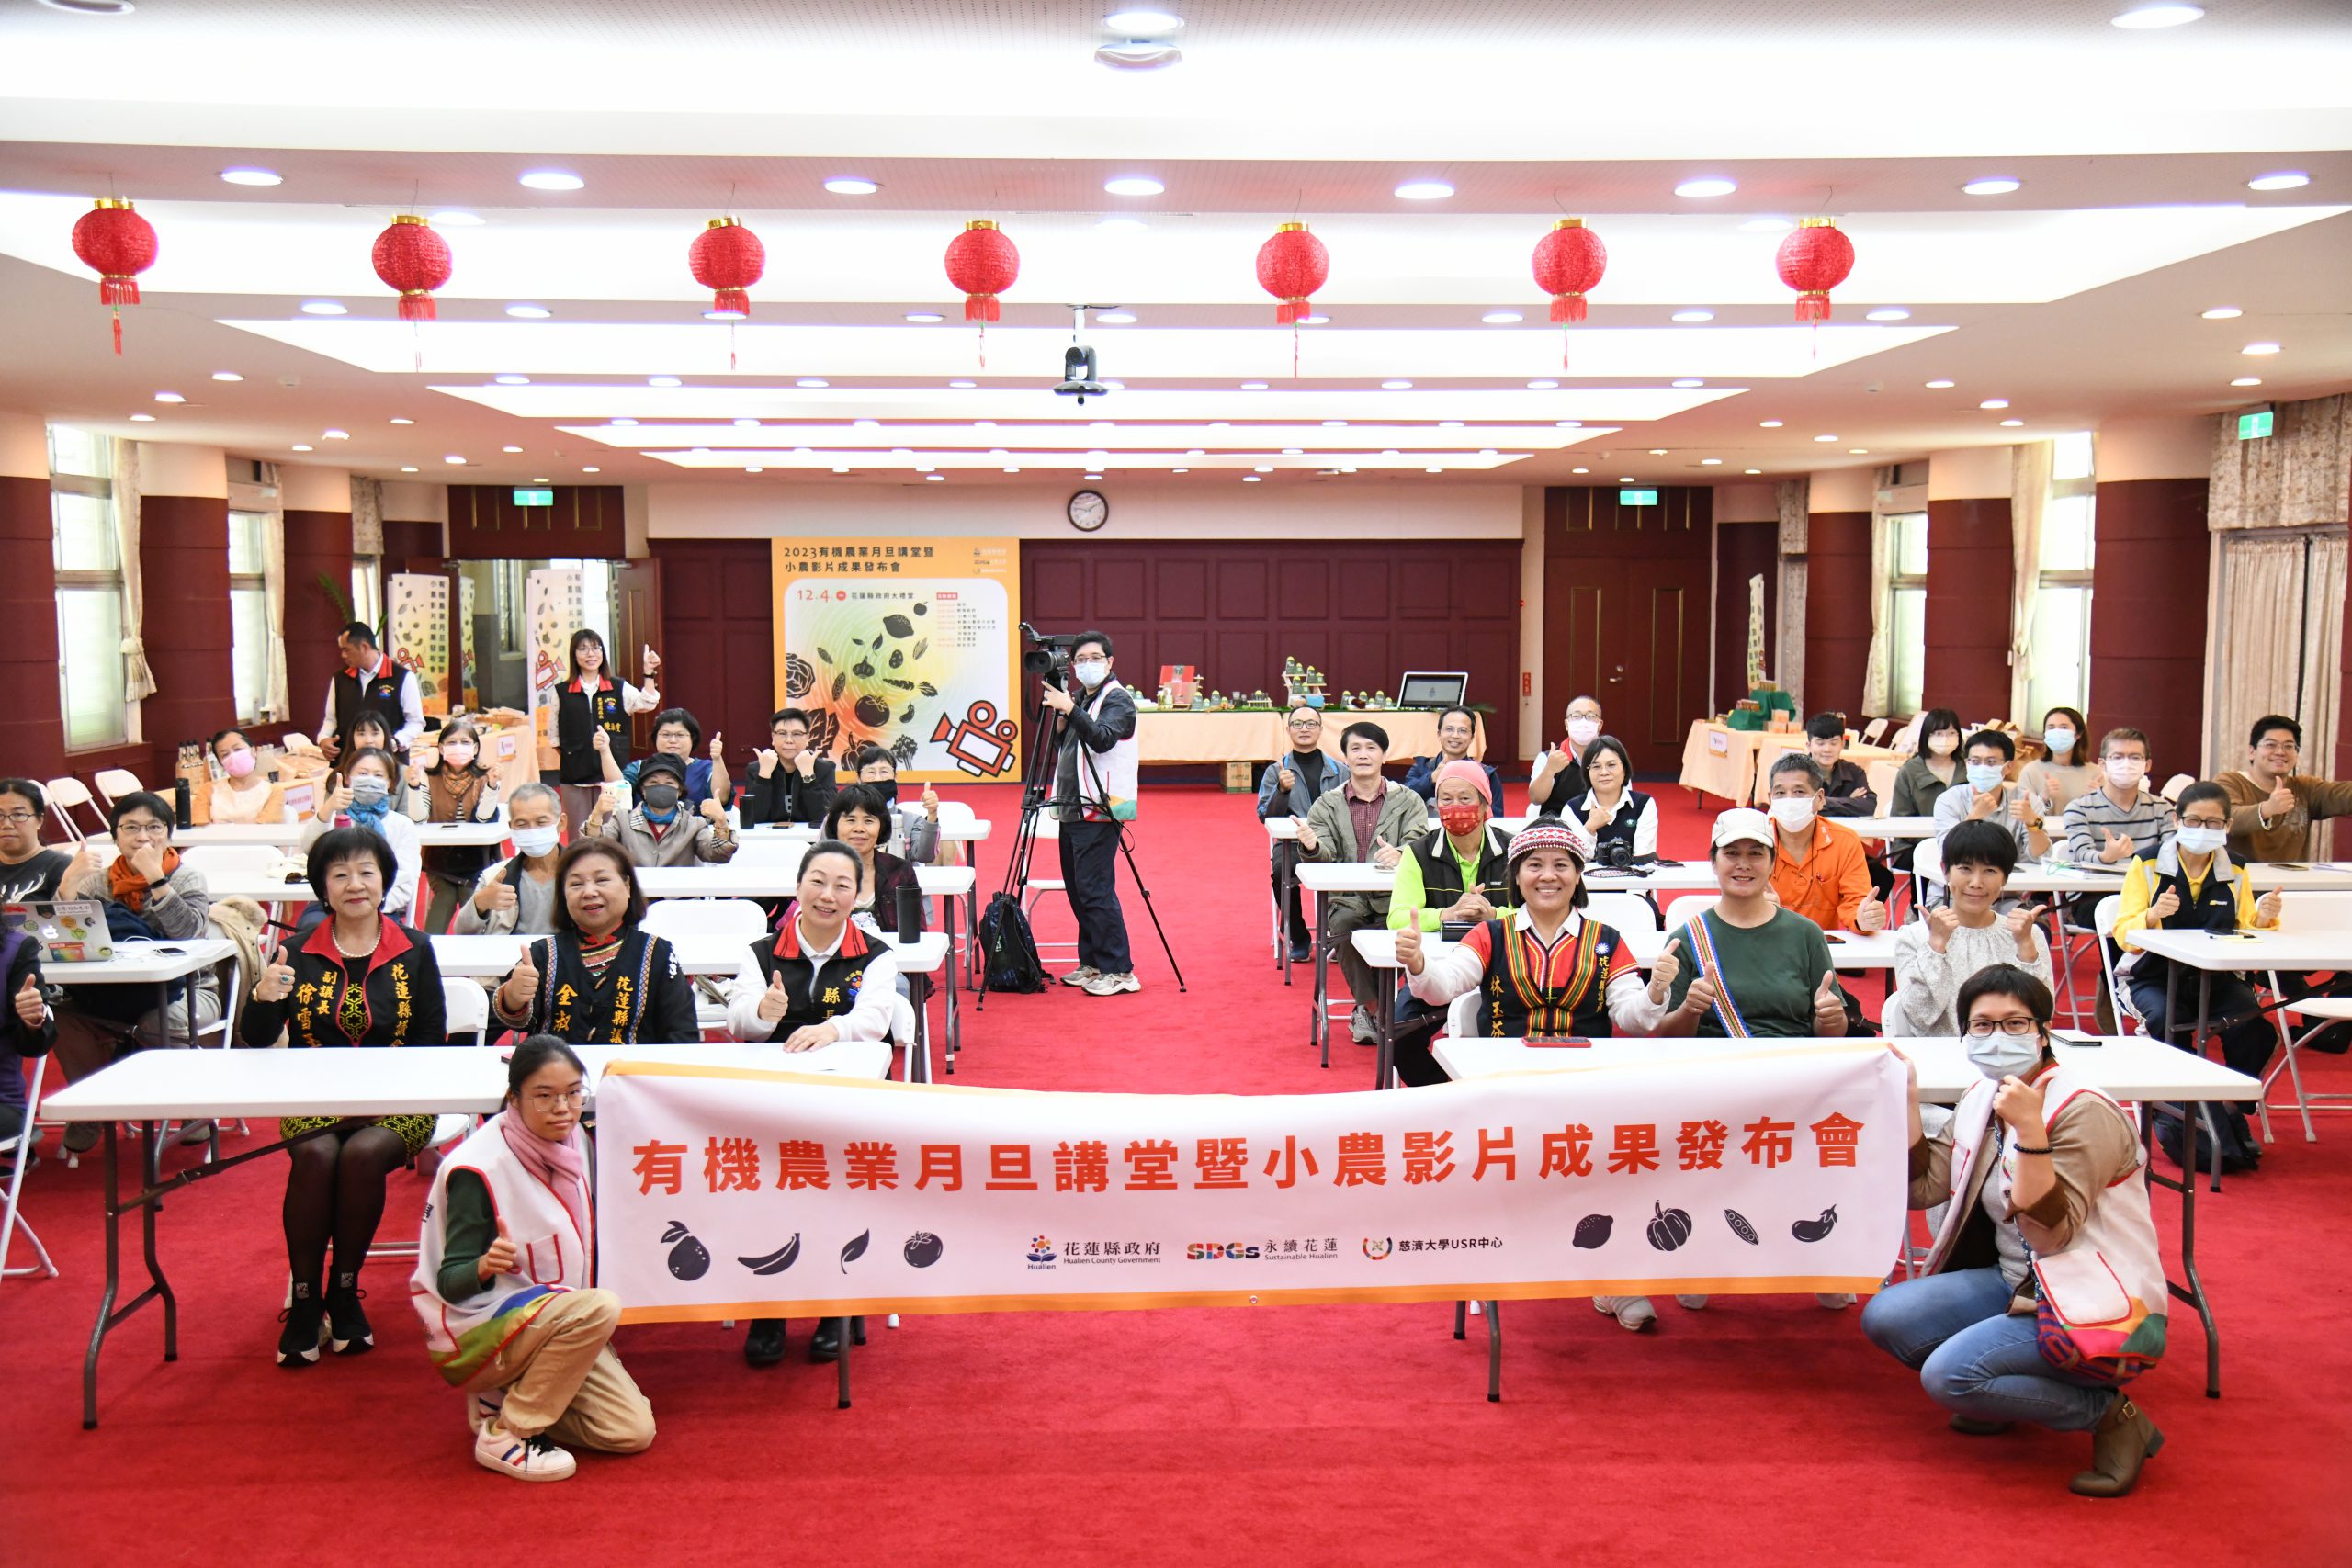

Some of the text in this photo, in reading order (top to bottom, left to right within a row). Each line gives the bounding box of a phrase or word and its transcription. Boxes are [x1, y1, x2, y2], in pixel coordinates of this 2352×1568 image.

[784, 546, 934, 559] 2023有機農業月旦講堂暨
[785, 561, 901, 572] 小農影片成果發布會
[316, 970, 338, 1015] 副議長
[632, 1111, 1866, 1196] 有機農業月旦講堂暨小農影片成果發布會
[1064, 1241, 1161, 1256] 花蓮縣政府
[1186, 1242, 1261, 1260] SDGs
[1264, 1237, 1339, 1253] 永續花蓮
[1398, 1236, 1503, 1252] 慈濟大學USR中心
[1063, 1257, 1161, 1266] Hualien County Government
[1264, 1253, 1307, 1261] Sustainable
[1027, 1263, 1057, 1271] Hualien
